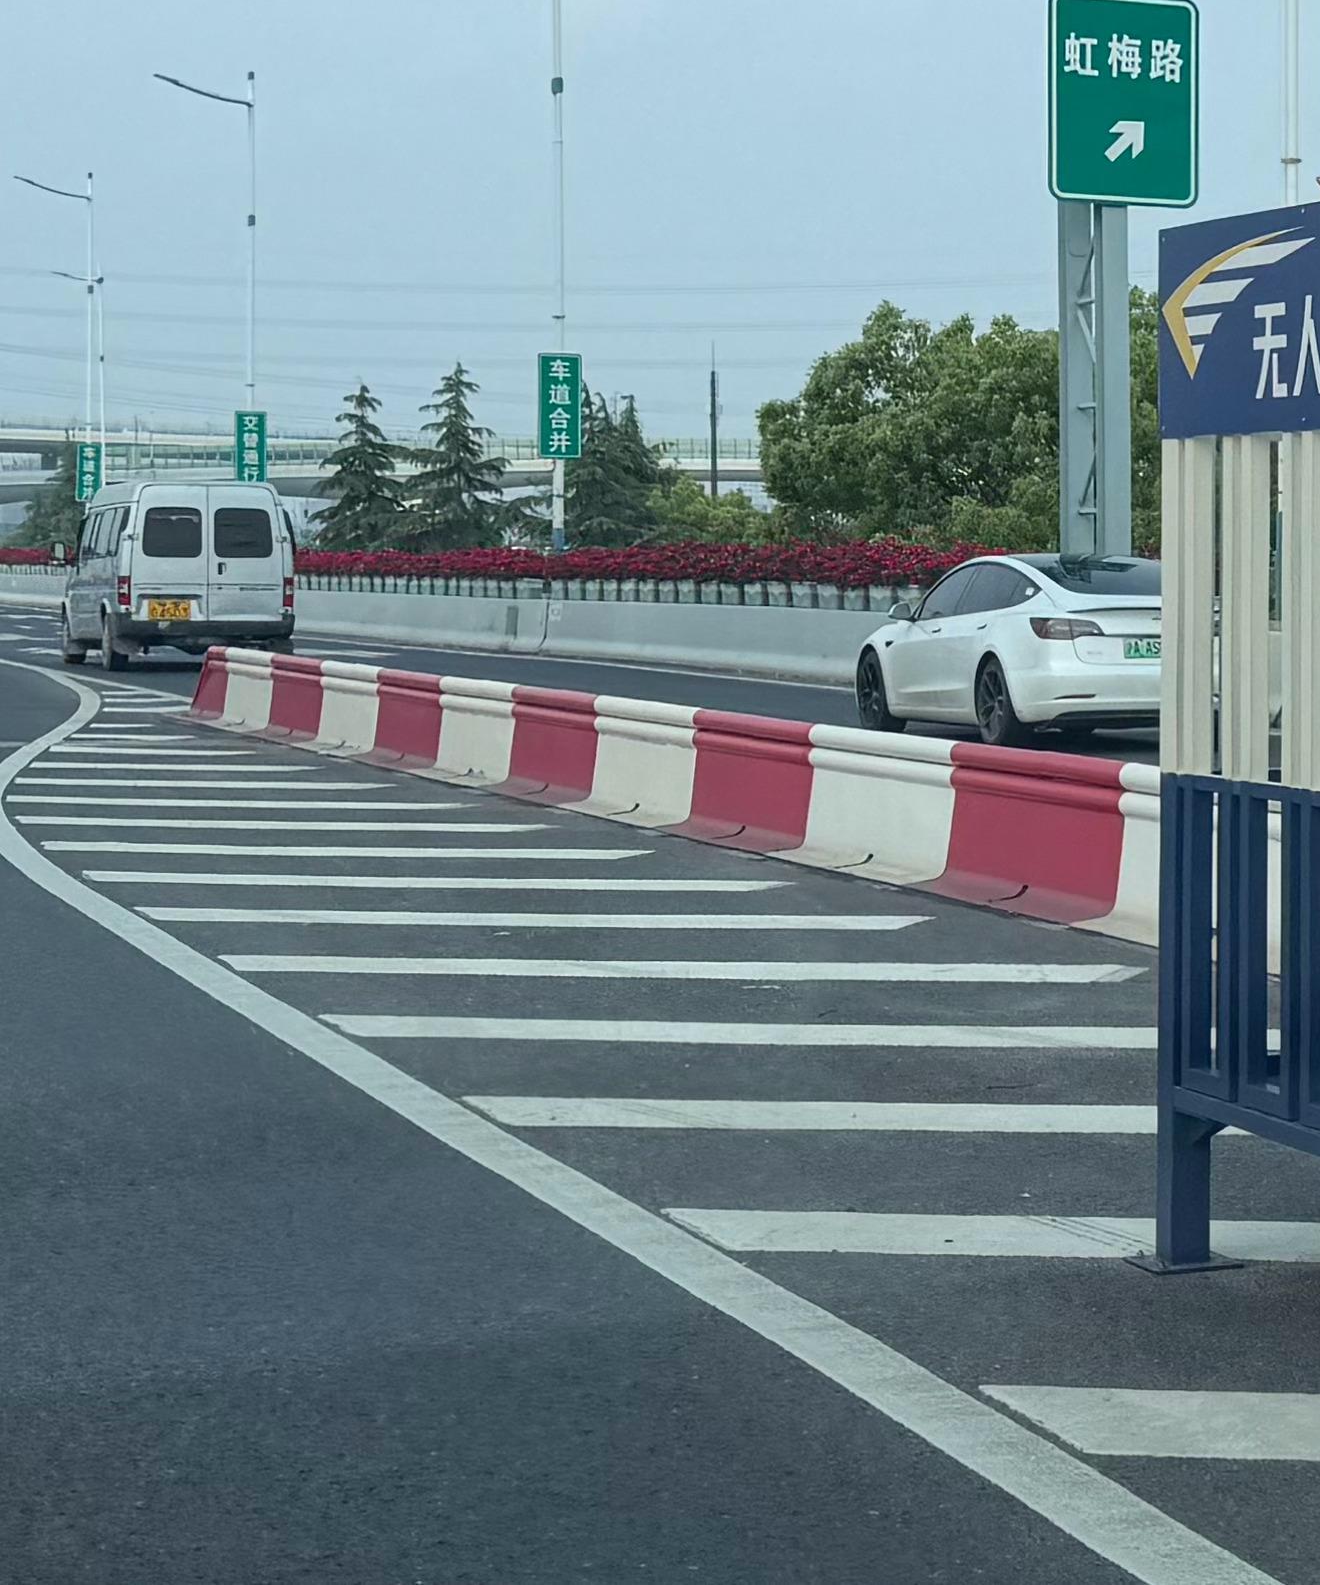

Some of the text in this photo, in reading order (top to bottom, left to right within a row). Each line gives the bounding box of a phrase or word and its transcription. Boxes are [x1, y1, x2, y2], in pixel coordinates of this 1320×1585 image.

[1064, 32, 1183, 83] 虹梅路
[548, 359, 571, 453] 车道合并
